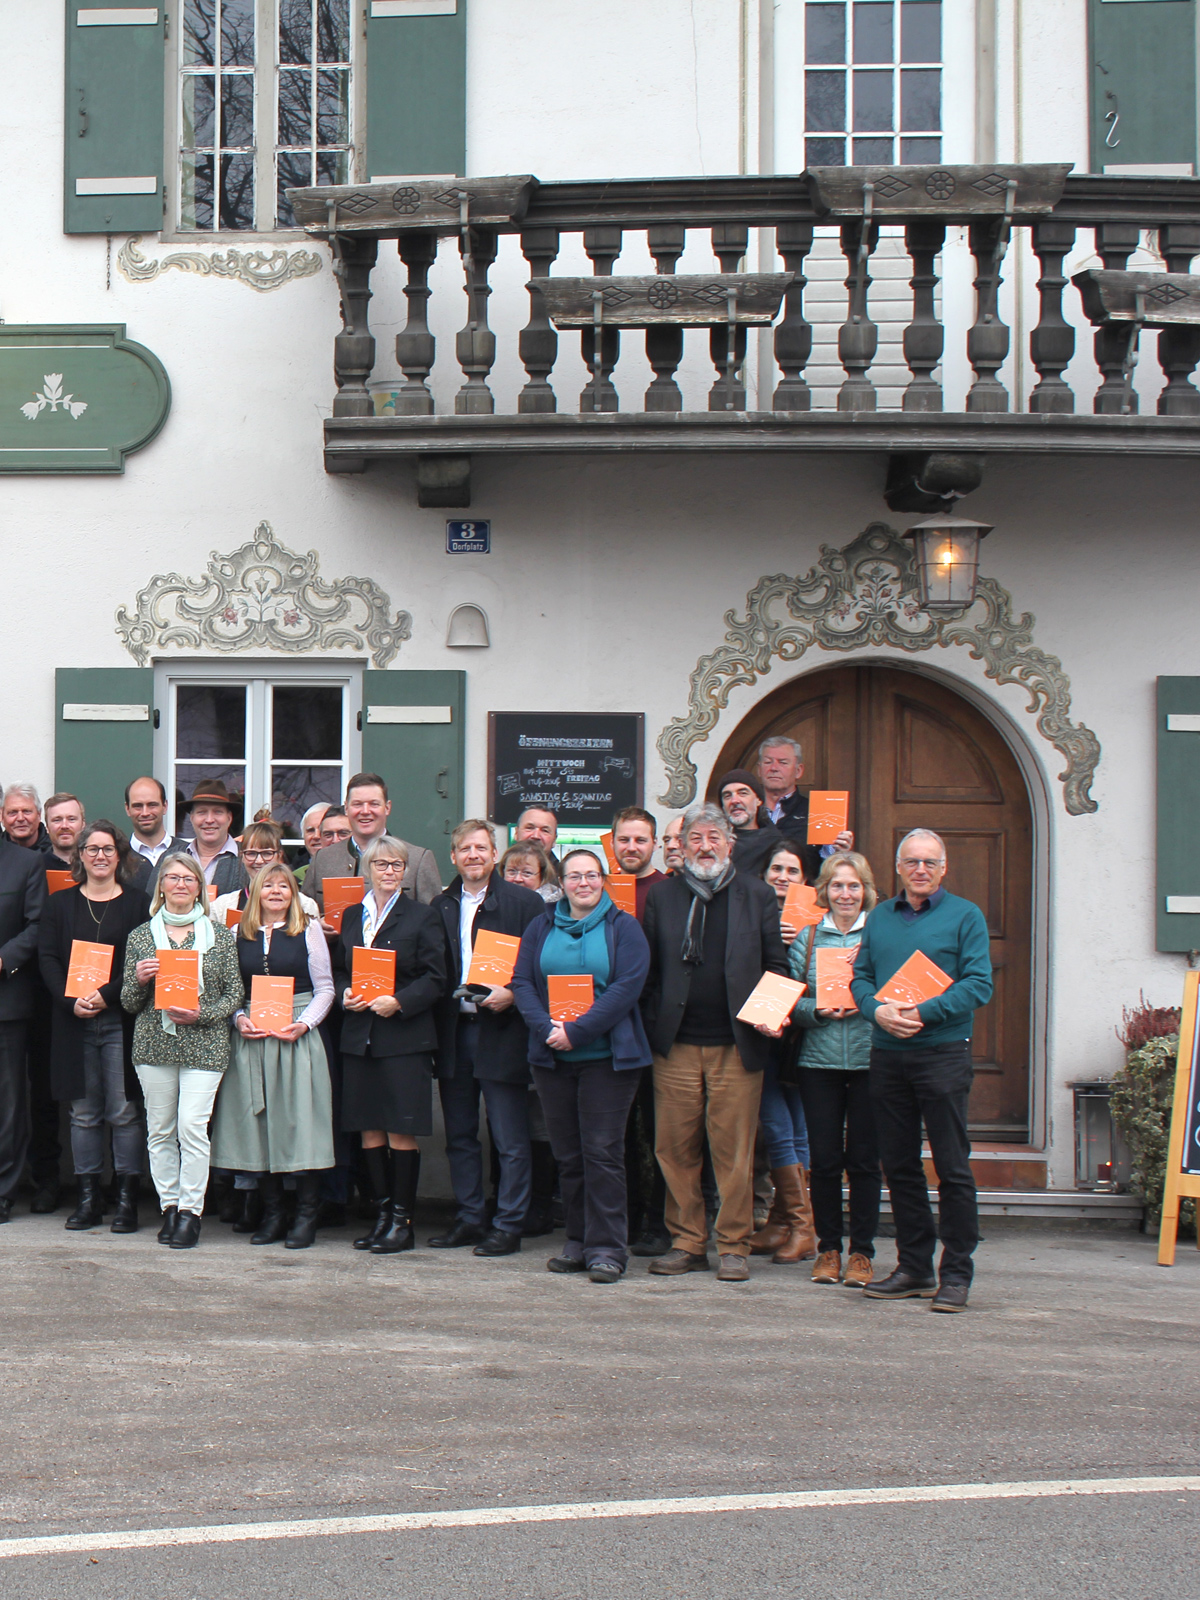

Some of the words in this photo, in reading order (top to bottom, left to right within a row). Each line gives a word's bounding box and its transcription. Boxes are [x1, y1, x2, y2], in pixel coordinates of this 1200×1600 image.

[460, 523, 475, 538] 3
[452, 542, 484, 551] Dorfplatz
[537, 759, 586, 767] MITTWOCH
[565, 774, 601, 783] FREITAG
[519, 792, 561, 801] SAMSTAG
[572, 792, 613, 801] SONNTAG
